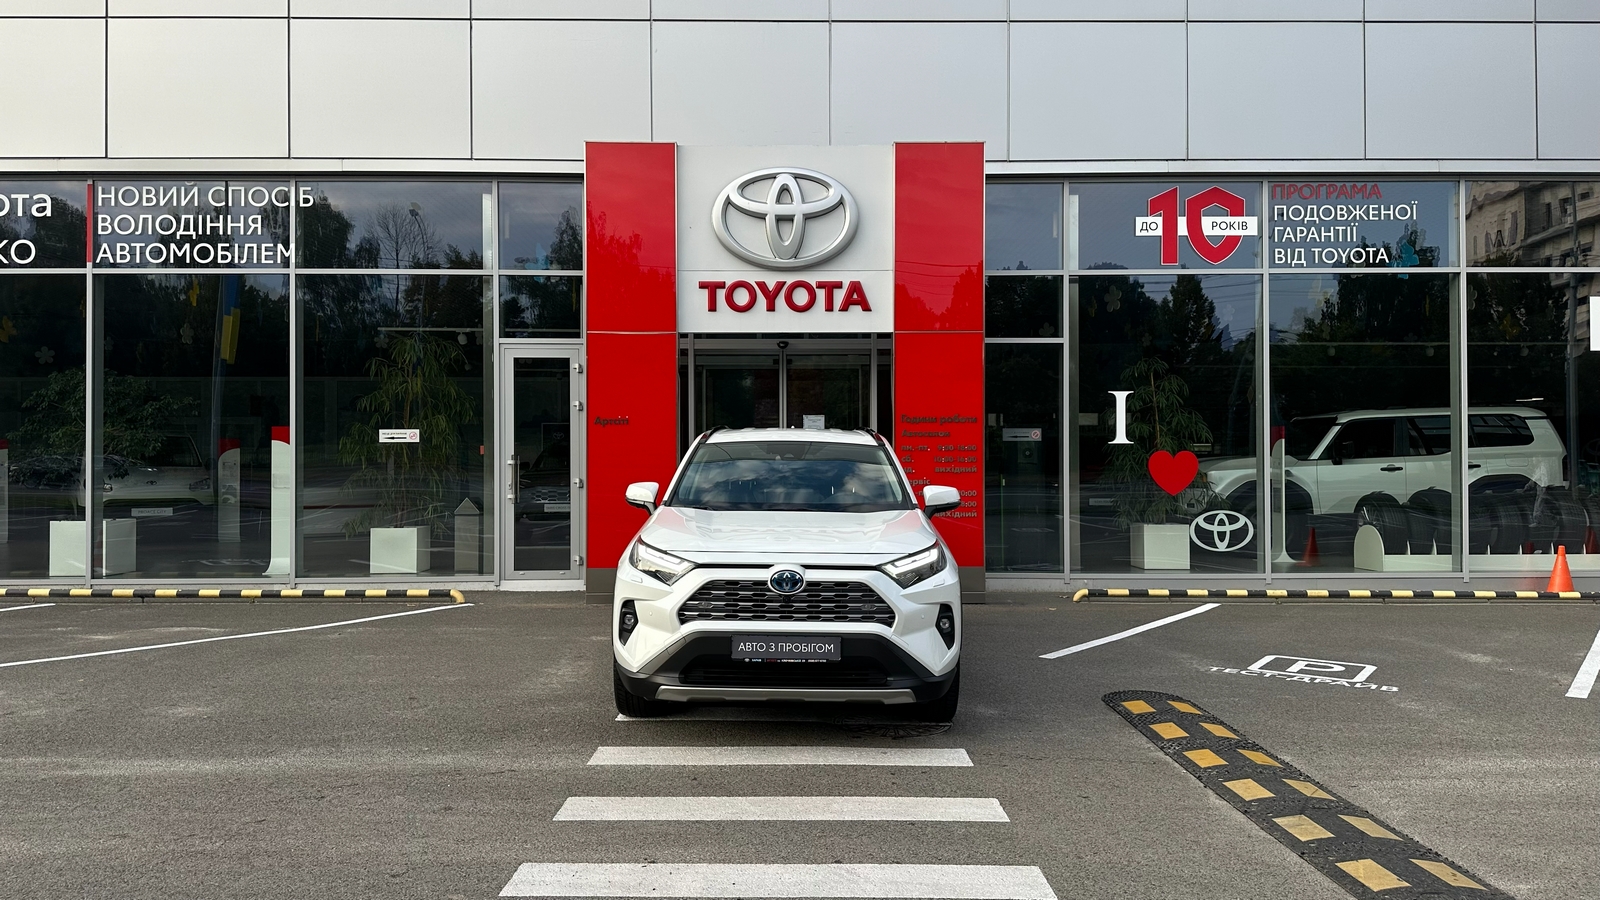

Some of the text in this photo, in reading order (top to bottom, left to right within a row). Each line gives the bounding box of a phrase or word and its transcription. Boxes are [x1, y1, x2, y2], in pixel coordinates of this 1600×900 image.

[98, 181, 315, 207] НОВИЙ СПОСІБ
[1272, 183, 1383, 200] ПРОГРАМА
[1273, 201, 1418, 223] ПОДОВЖЕНОЇ
[97, 214, 263, 239] ВОЛОДІННЯ
[1139, 221, 1159, 233] ДО
[1211, 221, 1249, 231] РОКІВ
[1273, 223, 1358, 242] ГАРАНТІЇ
[95, 243, 296, 264] АВТОМОБІЛЕМ
[1273, 248, 1390, 267] ВІД TOYOTA
[698, 280, 872, 312] TOYOTA
[939, 414, 977, 425] роботи
[1107, 391, 1134, 444] I
[909, 476, 931, 487] ервіс
[738, 642, 766, 652] АВТО
[778, 643, 834, 653] ПРОБІГОМ
[1209, 666, 1399, 692] ТЕСТ-ДРАЙВ
